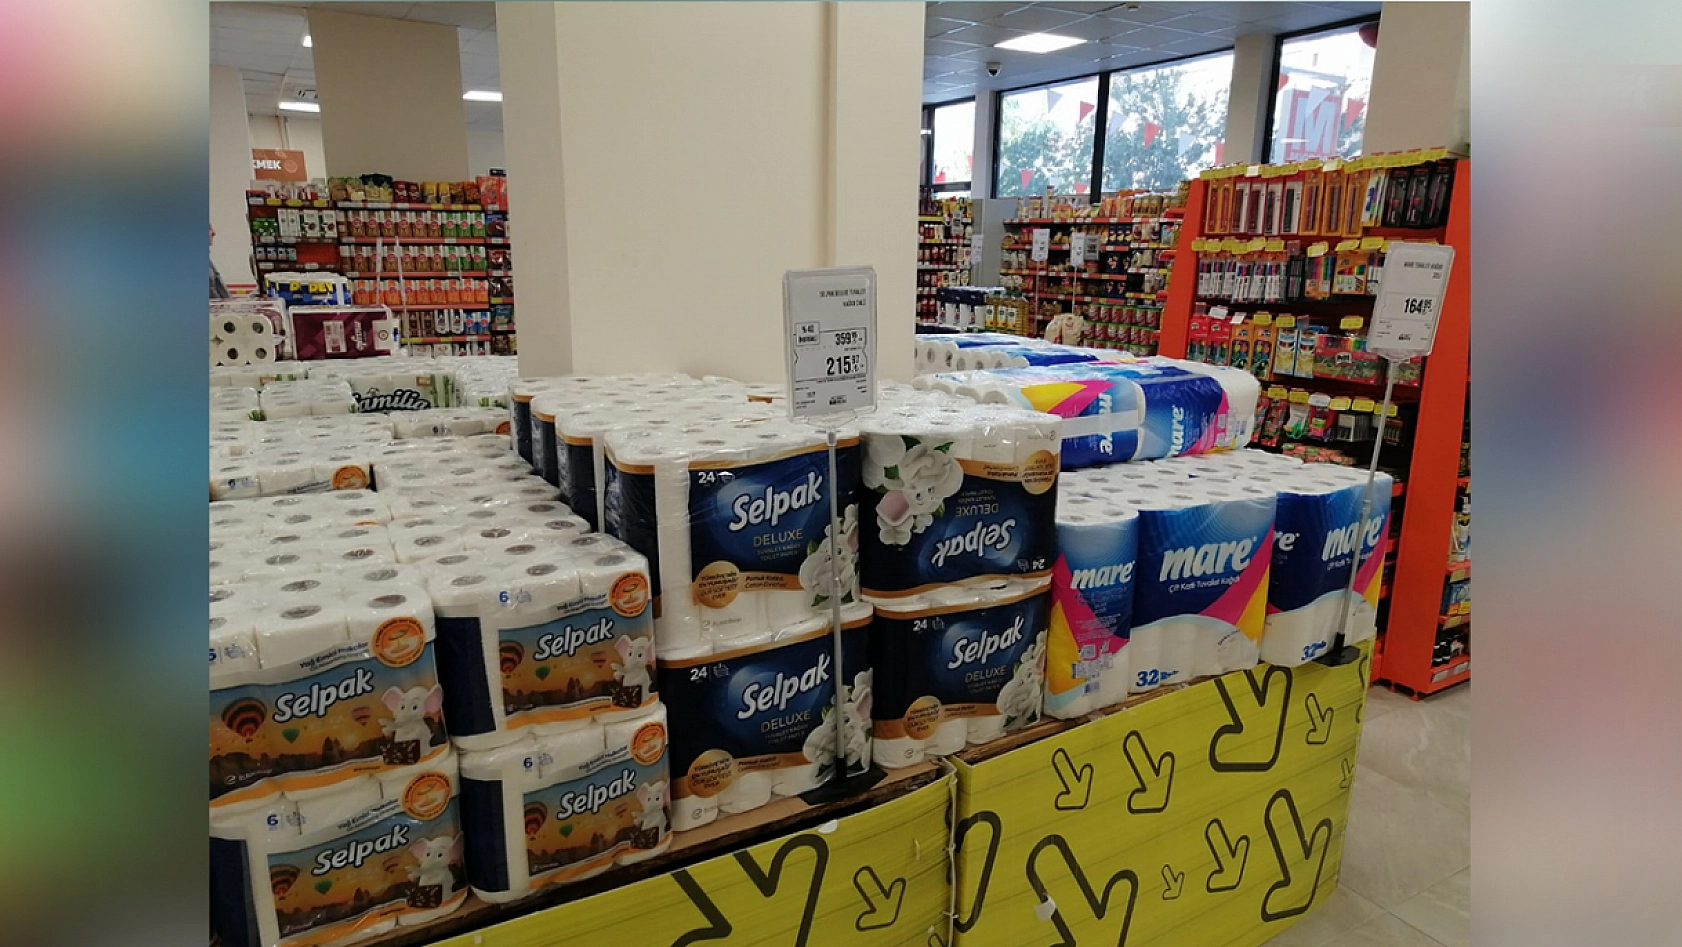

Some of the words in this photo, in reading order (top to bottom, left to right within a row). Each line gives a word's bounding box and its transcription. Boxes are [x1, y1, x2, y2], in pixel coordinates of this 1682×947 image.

[1404, 298, 1423, 314] 164
[835, 333, 851, 345] 359
[826, 356, 850, 375] 215
[698, 471, 716, 484] 24
[729, 472, 823, 531] Selpak
[955, 502, 999, 516] DELUXE
[753, 529, 803, 547] DELUXE
[931, 519, 1016, 567] Selpak
[1159, 537, 1252, 582] mare
[1070, 562, 1133, 589] mare
[500, 591, 509, 603] 6
[913, 620, 927, 632] 24
[533, 617, 615, 661] Selpak
[948, 615, 1024, 669] Selpak
[690, 667, 708, 681] 24
[965, 665, 1007, 683] DELUXE
[1136, 668, 1159, 686] 32
[274, 668, 374, 722] Selpak
[737, 653, 831, 720] Selpak
[760, 709, 812, 733] DELUXE
[524, 757, 533, 769] 6
[557, 769, 636, 820] Selpak
[267, 815, 279, 826] 6
[311, 824, 410, 876] Selpak
